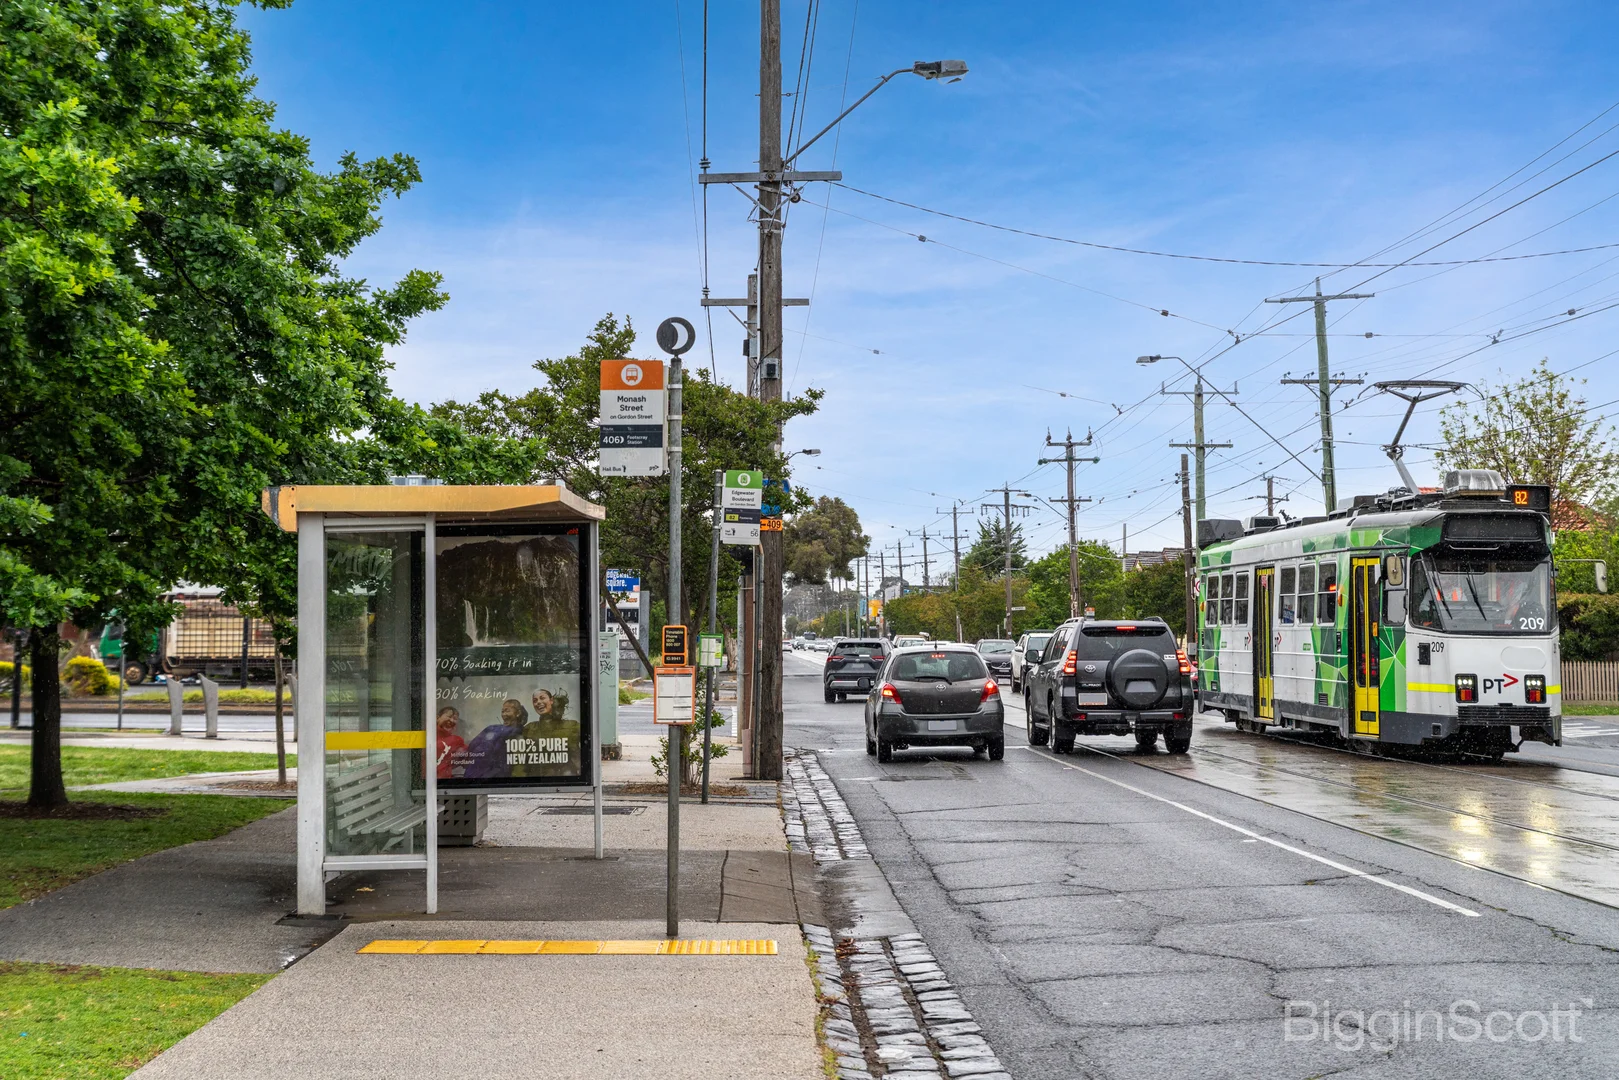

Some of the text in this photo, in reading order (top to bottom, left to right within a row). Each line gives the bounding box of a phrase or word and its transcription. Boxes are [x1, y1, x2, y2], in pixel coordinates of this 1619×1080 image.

[617, 395, 647, 403] Monash
[620, 404, 644, 412] Street
[602, 436, 619, 444] 406
[1514, 491, 1528, 505] 82
[1519, 617, 1545, 630] 209
[1431, 642, 1445, 652] 209
[463, 655, 502, 671] Soaking
[522, 658, 532, 667] in
[462, 685, 508, 700] Soaking
[505, 738, 568, 753] 100% PURE
[506, 752, 568, 765] NEW ZEALAND
